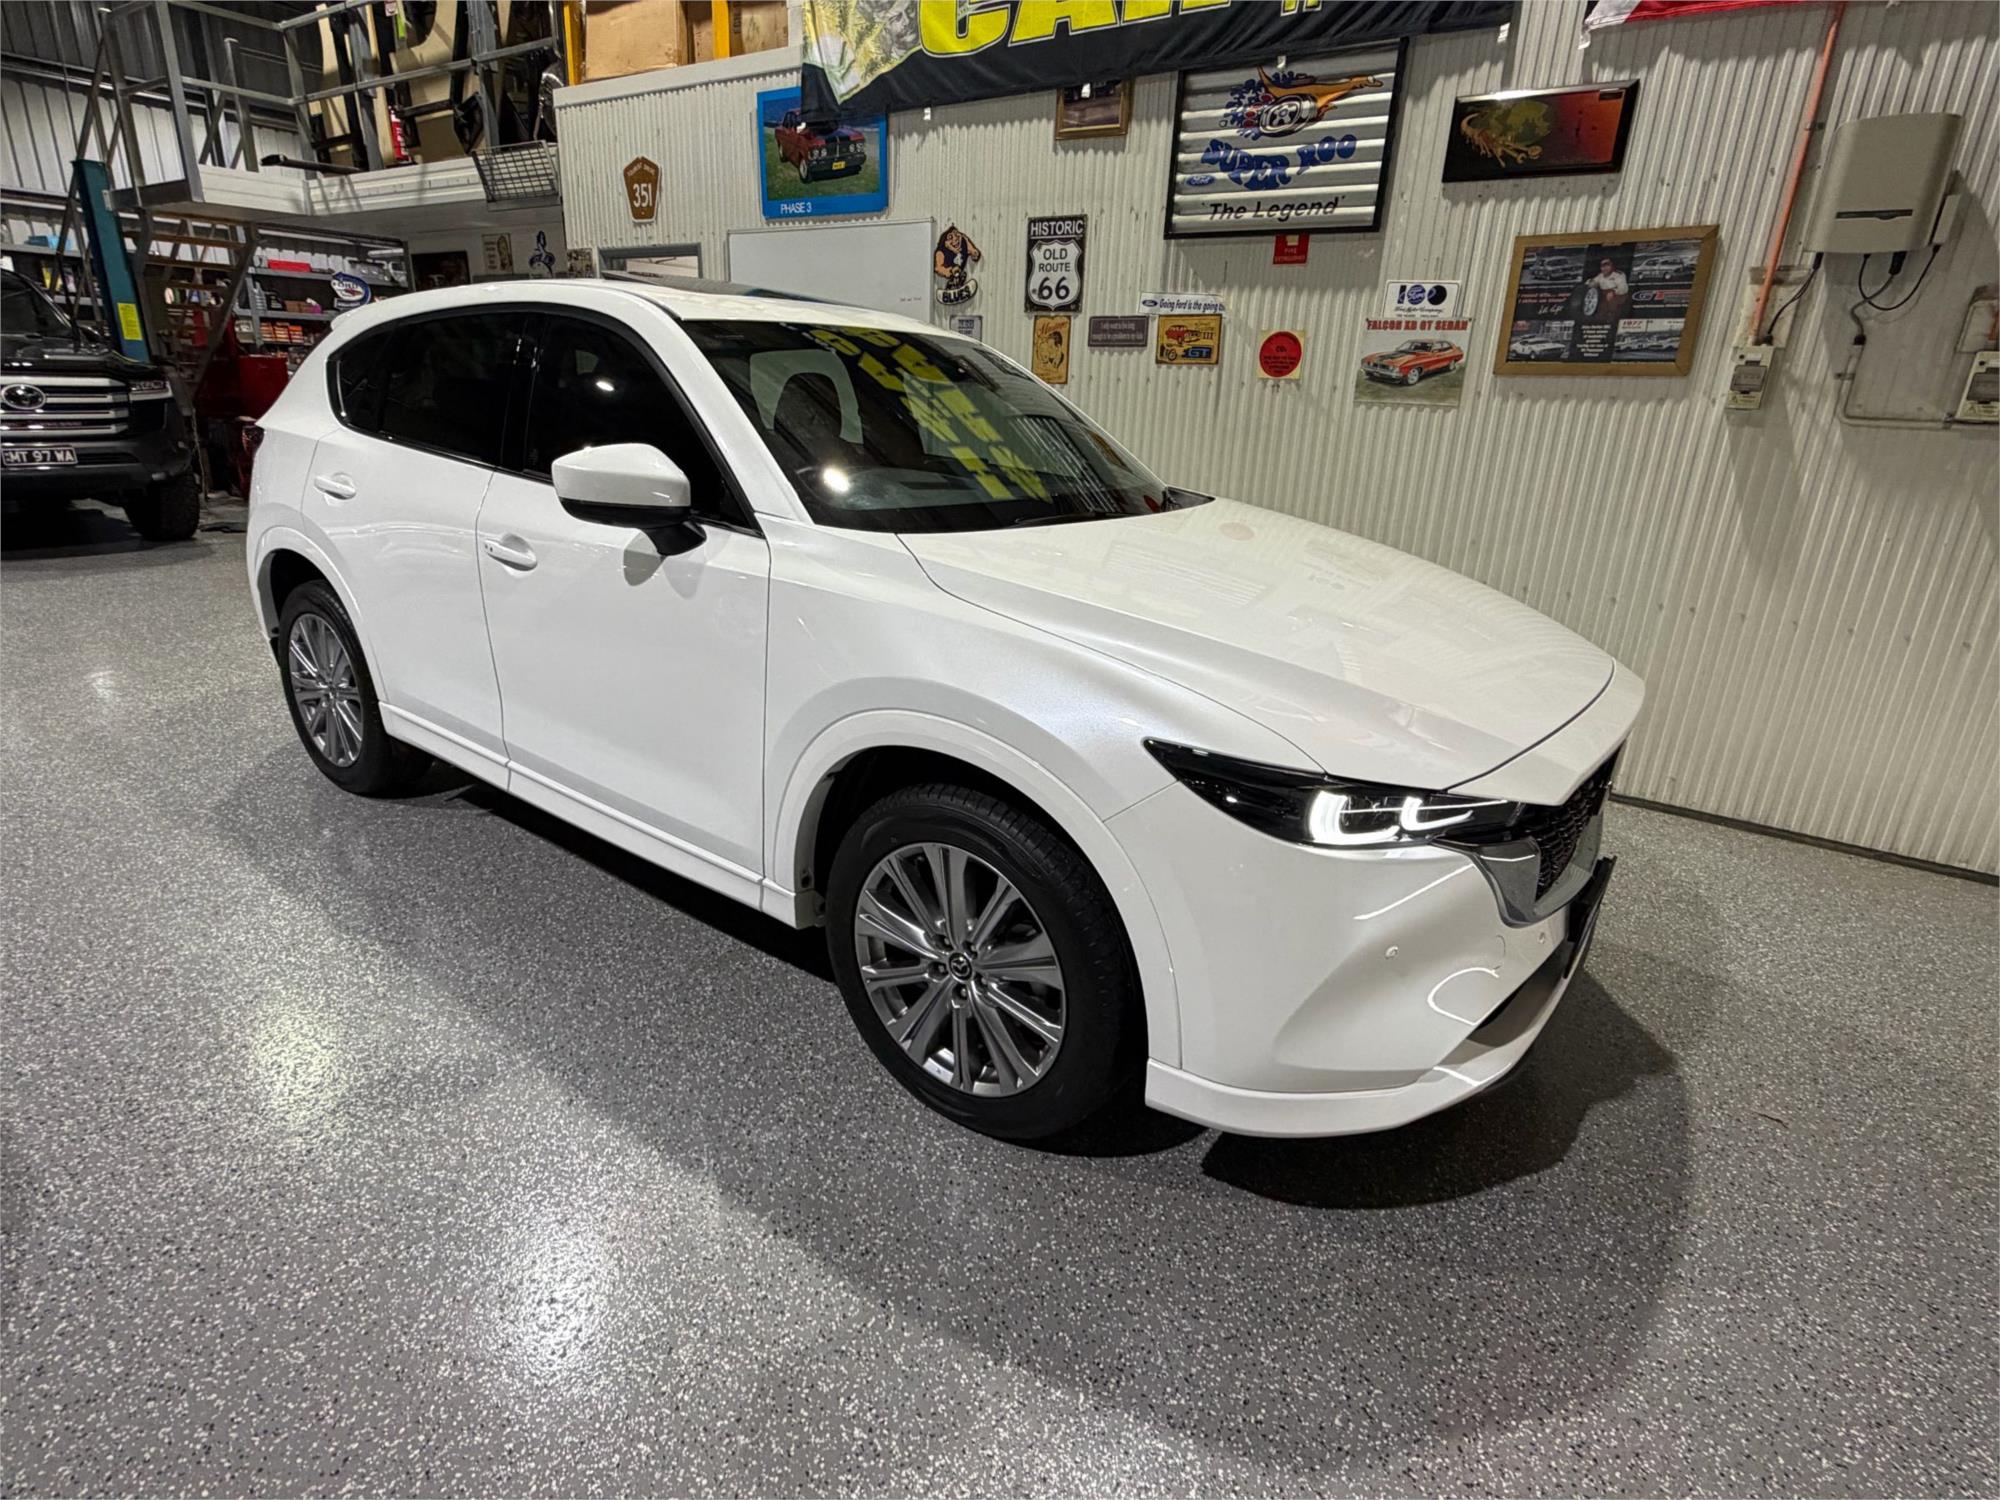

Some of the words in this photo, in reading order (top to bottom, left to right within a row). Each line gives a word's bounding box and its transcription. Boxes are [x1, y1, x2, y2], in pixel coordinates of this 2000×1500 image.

[1201, 139, 1292, 191] SUPER
[1297, 134, 1357, 175] ROO
[633, 183, 653, 208] 351
[780, 202, 805, 214] PHASE
[806, 202, 812, 213] 3
[1030, 220, 1084, 236] HISTORIC
[1043, 248, 1068, 261] OLD
[1038, 262, 1071, 273] ROUTE
[942, 285, 971, 303] BLUES
[1038, 276, 1070, 300] 66
[1159, 299, 1175, 312] Going
[1175, 299, 1188, 310] Ford
[1188, 300, 1193, 310] is
[1193, 300, 1202, 311] the
[1202, 301, 1218, 313] going
[1366, 320, 1402, 331] FALCON
[1420, 320, 1434, 331] GT
[1435, 320, 1468, 331] SEDAN
[1188, 348, 1211, 358] GT
[32, 451, 51, 463] 97
[55, 450, 74, 462] WA
